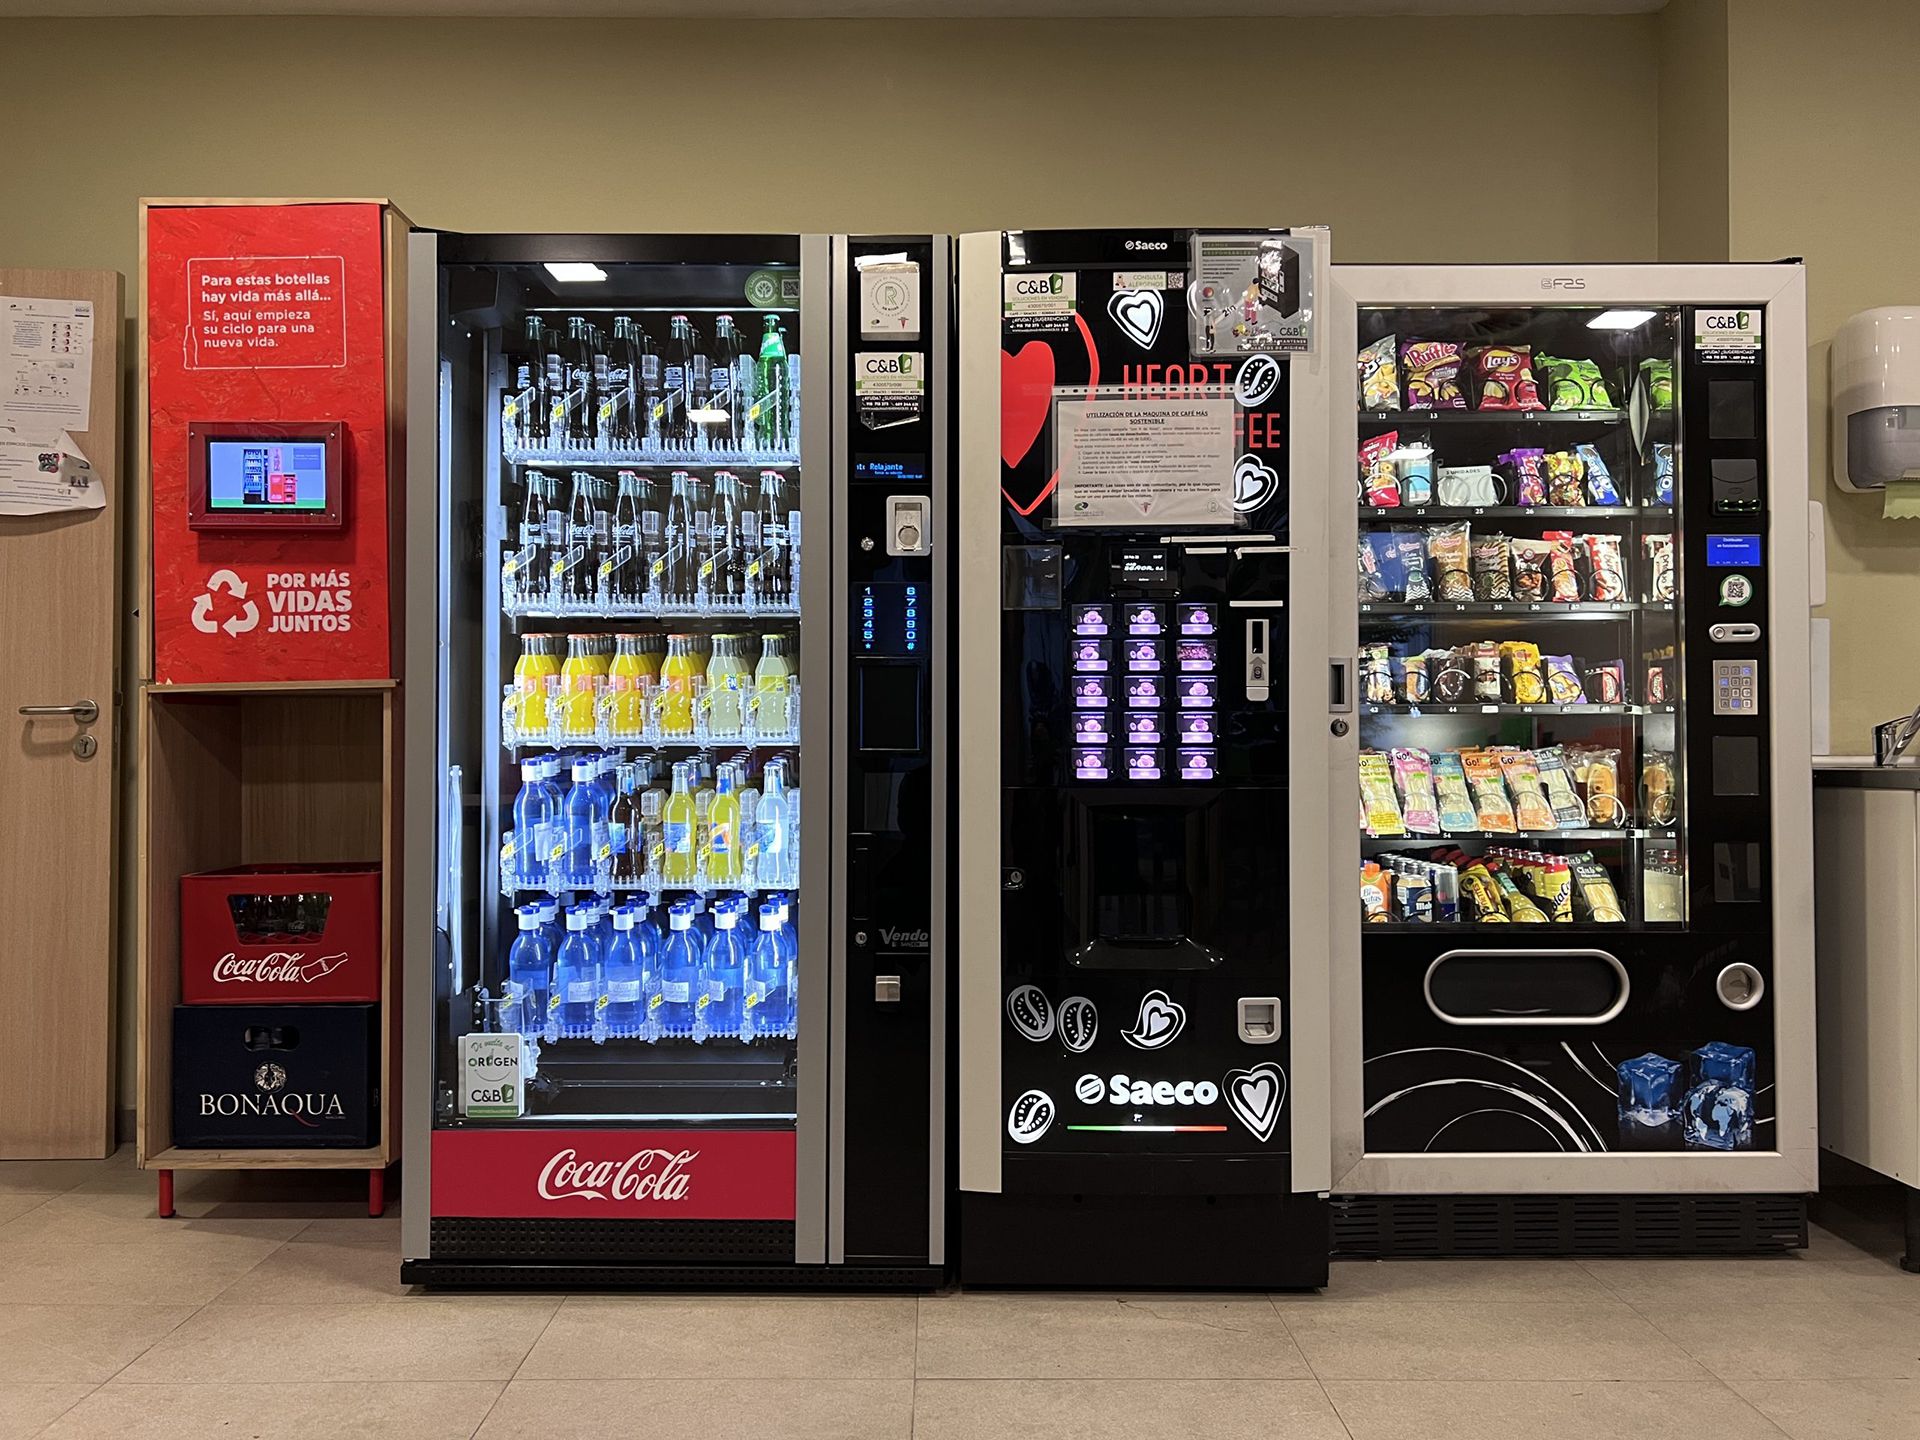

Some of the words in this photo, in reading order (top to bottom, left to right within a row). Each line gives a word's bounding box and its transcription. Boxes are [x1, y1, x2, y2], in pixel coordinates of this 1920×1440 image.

[1135, 240, 1168, 250] Saeco
[201, 275, 232, 286] Para
[235, 275, 271, 286] estas
[275, 273, 331, 286] botellas
[1017, 280, 1049, 294] C&B
[201, 291, 225, 304] hay
[230, 290, 260, 302] vida
[263, 290, 291, 302] más
[295, 289, 332, 302] allá...
[203, 310, 219, 323] Sí,
[223, 310, 252, 323] aquí
[255, 310, 311, 323] empieza
[1706, 316, 1736, 329] C&B
[203, 326, 218, 335] su
[222, 324, 253, 335] ciclo
[257, 325, 287, 336] para
[290, 325, 315, 334] una
[1280, 327, 1299, 337] C&B
[203, 339, 243, 348] nueva
[247, 336, 279, 348] vida.
[866, 360, 898, 373] C&B
[1123, 364, 1232, 400] HEART
[1086, 410, 1124, 418] UTILIZACIÓN
[1180, 409, 1195, 417] CAFÉ
[1196, 409, 1209, 417] MÁS
[267, 573, 306, 589] POR
[310, 569, 350, 588] MÁS
[864, 587, 871, 595] 1
[906, 587, 916, 595] 6
[266, 589, 353, 613] VIDAS
[863, 598, 873, 606] 2
[906, 598, 916, 606] 7
[863, 609, 873, 617] 3
[906, 609, 916, 617] 8
[268, 614, 352, 633] JUNTOS
[863, 620, 873, 628] 4
[906, 620, 916, 628] 9
[863, 631, 873, 640] 5
[906, 631, 916, 640] 0
[878, 926, 929, 945] Vendo
[212, 952, 306, 983] Coca-Cola
[468, 1055, 518, 1067] ORIGEN
[471, 1089, 501, 1103] C&B
[1109, 1074, 1219, 1106] Saeco
[200, 1093, 345, 1119] BONAQUA
[537, 1149, 700, 1201] Coca-Cola
